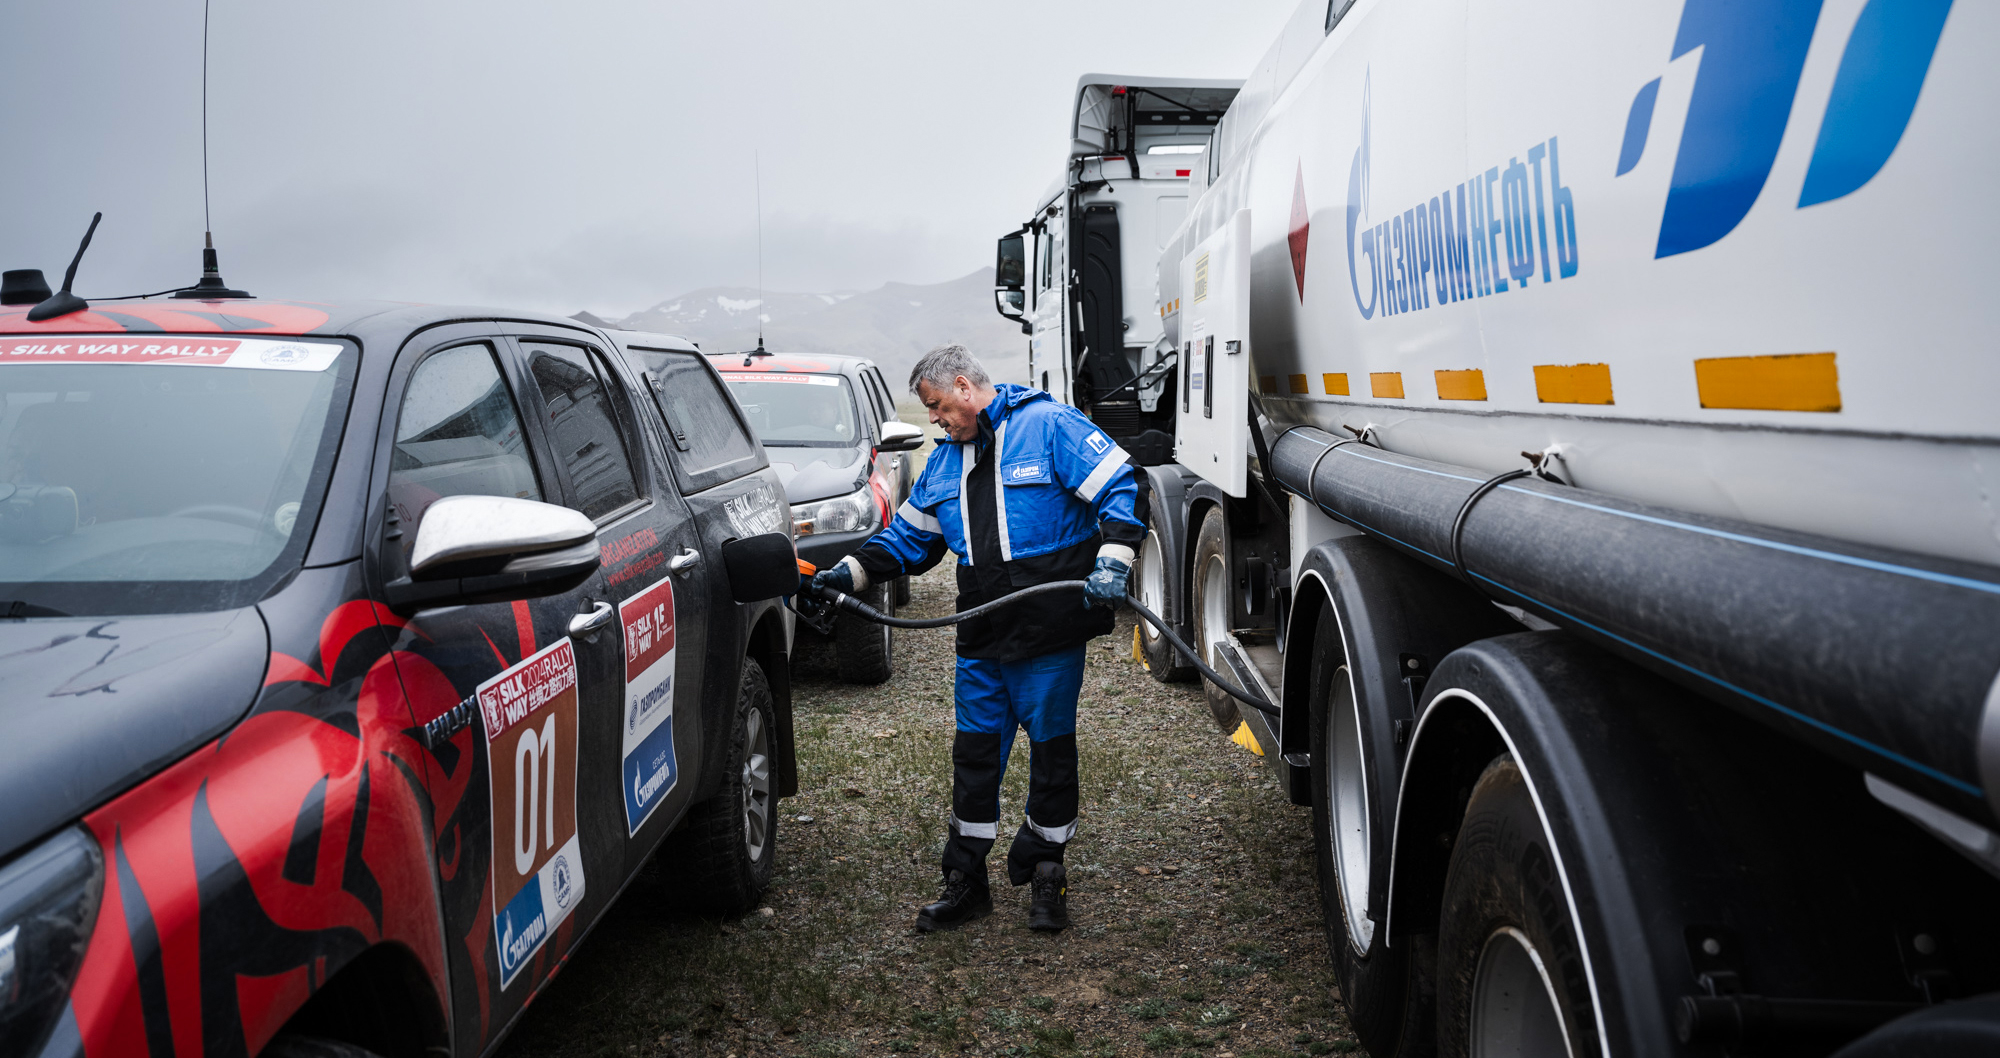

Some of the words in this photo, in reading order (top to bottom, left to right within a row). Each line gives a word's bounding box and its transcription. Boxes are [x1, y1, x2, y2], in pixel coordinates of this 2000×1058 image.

[1375, 135, 1578, 317] ГАЗПРОМНЕФТЬ
[10, 344, 71, 356] SILK
[77, 344, 140, 356] WAY
[140, 344, 230, 357] RALLY
[734, 494, 754, 518] SILK
[599, 526, 659, 568] ORGANIZATION
[637, 612, 652, 637] SILK
[638, 630, 652, 654] WAY
[500, 673, 526, 705] SILK
[424, 694, 476, 751] HILUX
[505, 693, 529, 725] WAY
[514, 712, 555, 876] 01
[514, 912, 545, 961] GAZPROM
